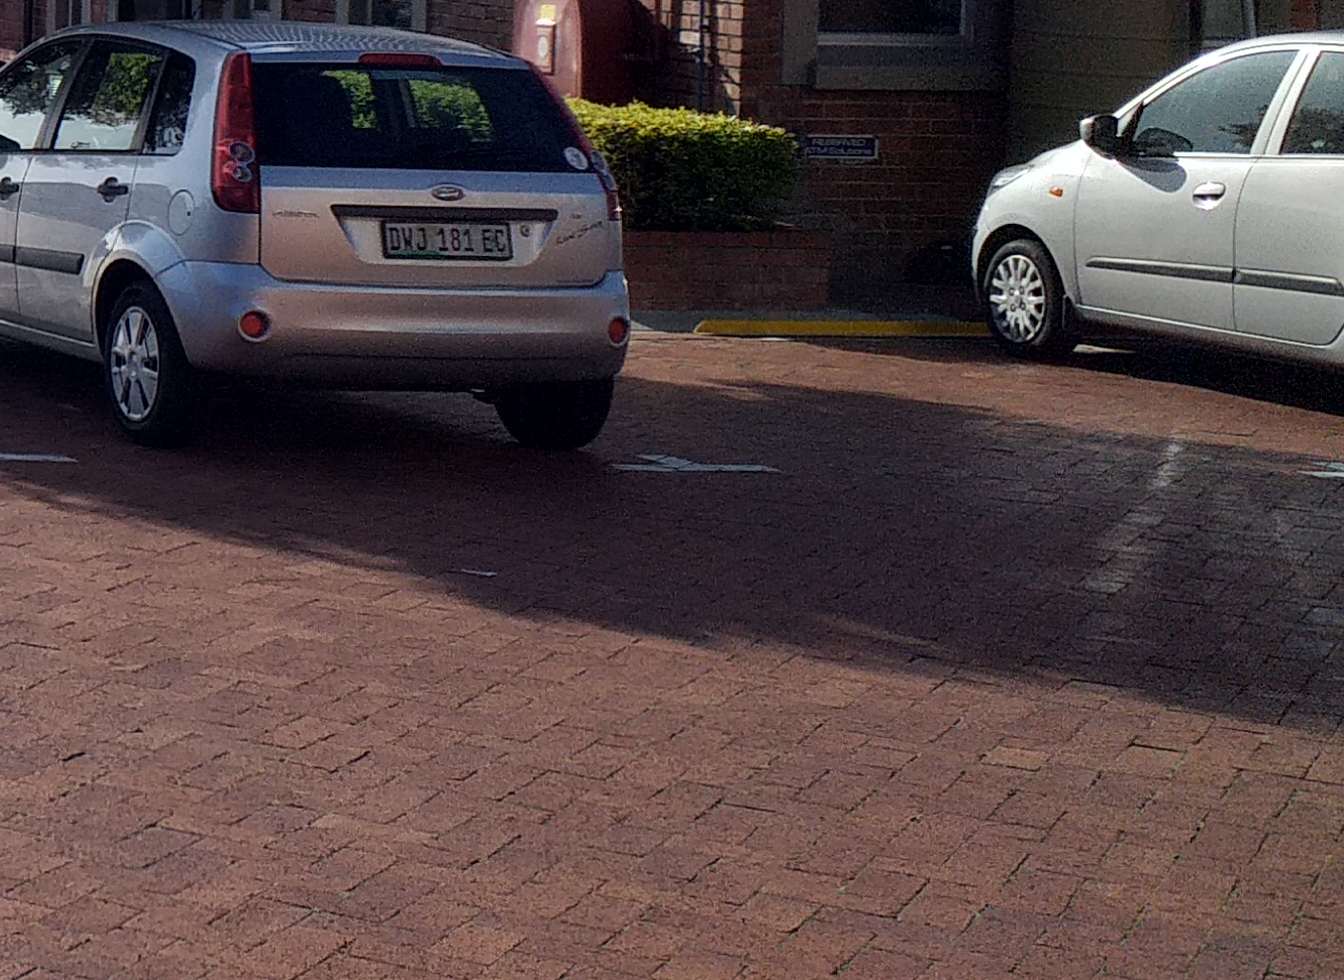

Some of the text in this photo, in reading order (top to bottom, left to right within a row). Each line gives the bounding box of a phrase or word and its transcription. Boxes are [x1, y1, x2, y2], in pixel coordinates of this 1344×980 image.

[811, 138, 866, 147] RESERVED
[388, 226, 506, 253] DWJ 181 EC
